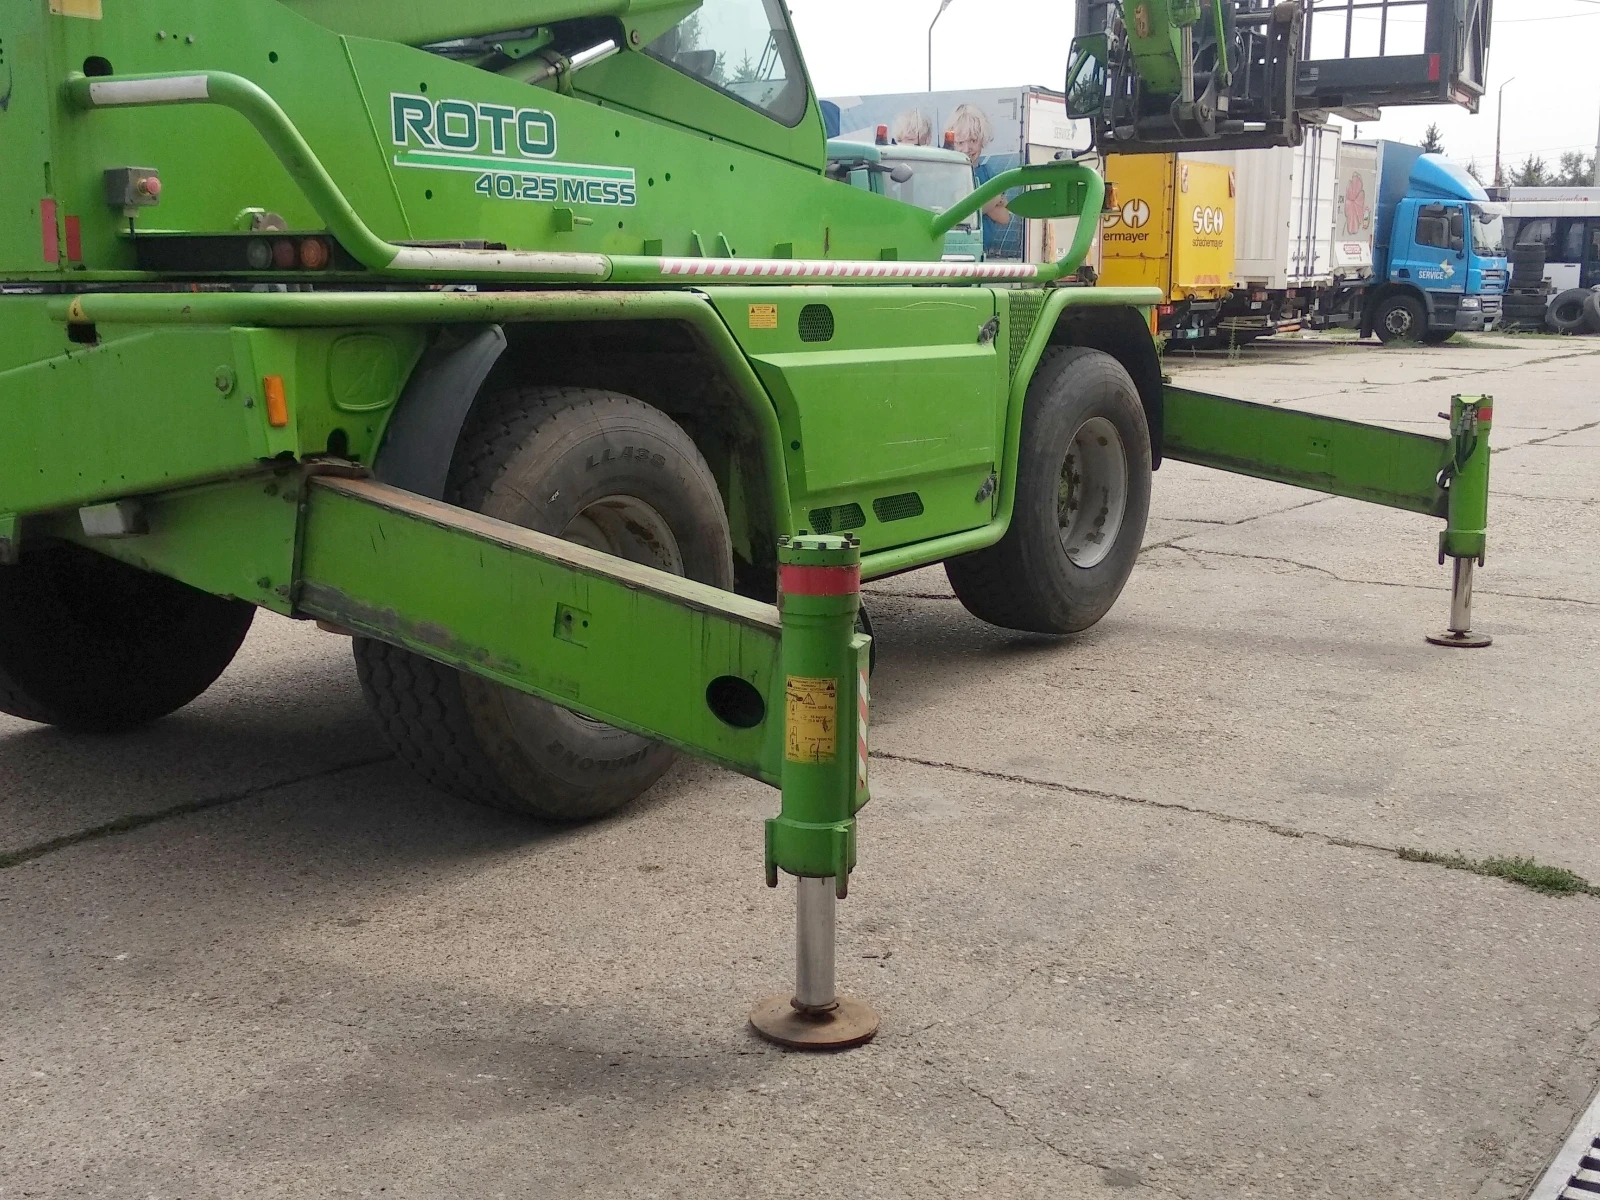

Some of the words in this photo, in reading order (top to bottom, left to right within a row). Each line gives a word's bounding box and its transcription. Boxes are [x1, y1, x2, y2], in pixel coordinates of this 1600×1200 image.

[391, 93, 557, 158] ROTO
[475, 173, 558, 200] 40.25
[563, 179, 636, 206] MCSS
[1193, 205, 1224, 235] SCH
[1418, 270, 1444, 280] SERVICE
